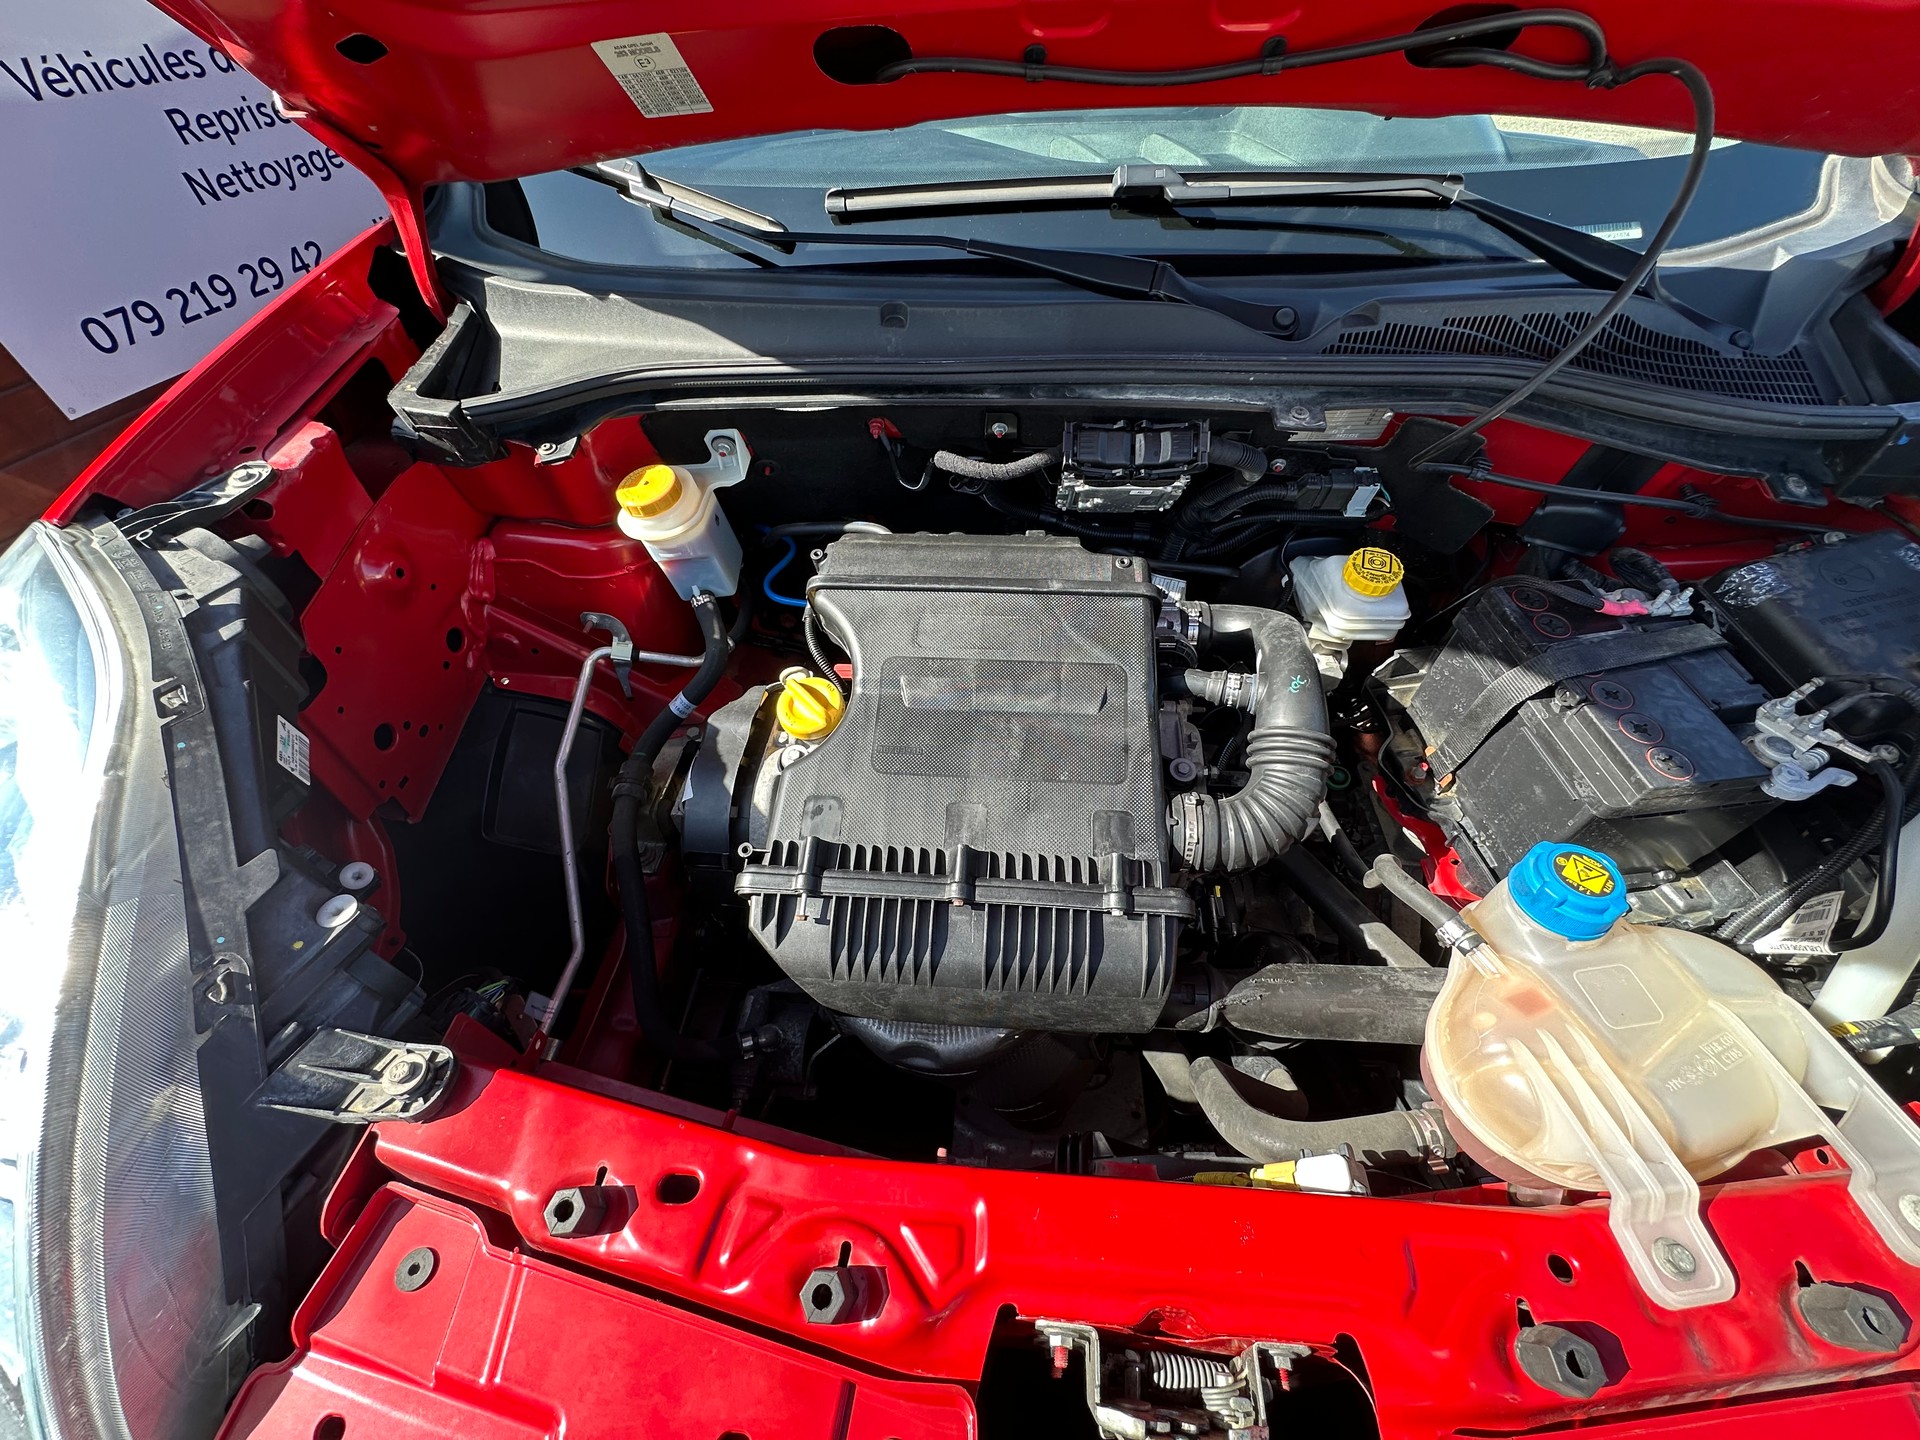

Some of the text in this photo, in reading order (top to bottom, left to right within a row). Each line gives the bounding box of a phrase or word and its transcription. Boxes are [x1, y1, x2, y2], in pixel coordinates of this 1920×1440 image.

[0, 43, 206, 101] Véhicules
[182, 147, 344, 206] Nettoyage
[80, 241, 322, 354] 079 219 29 42
